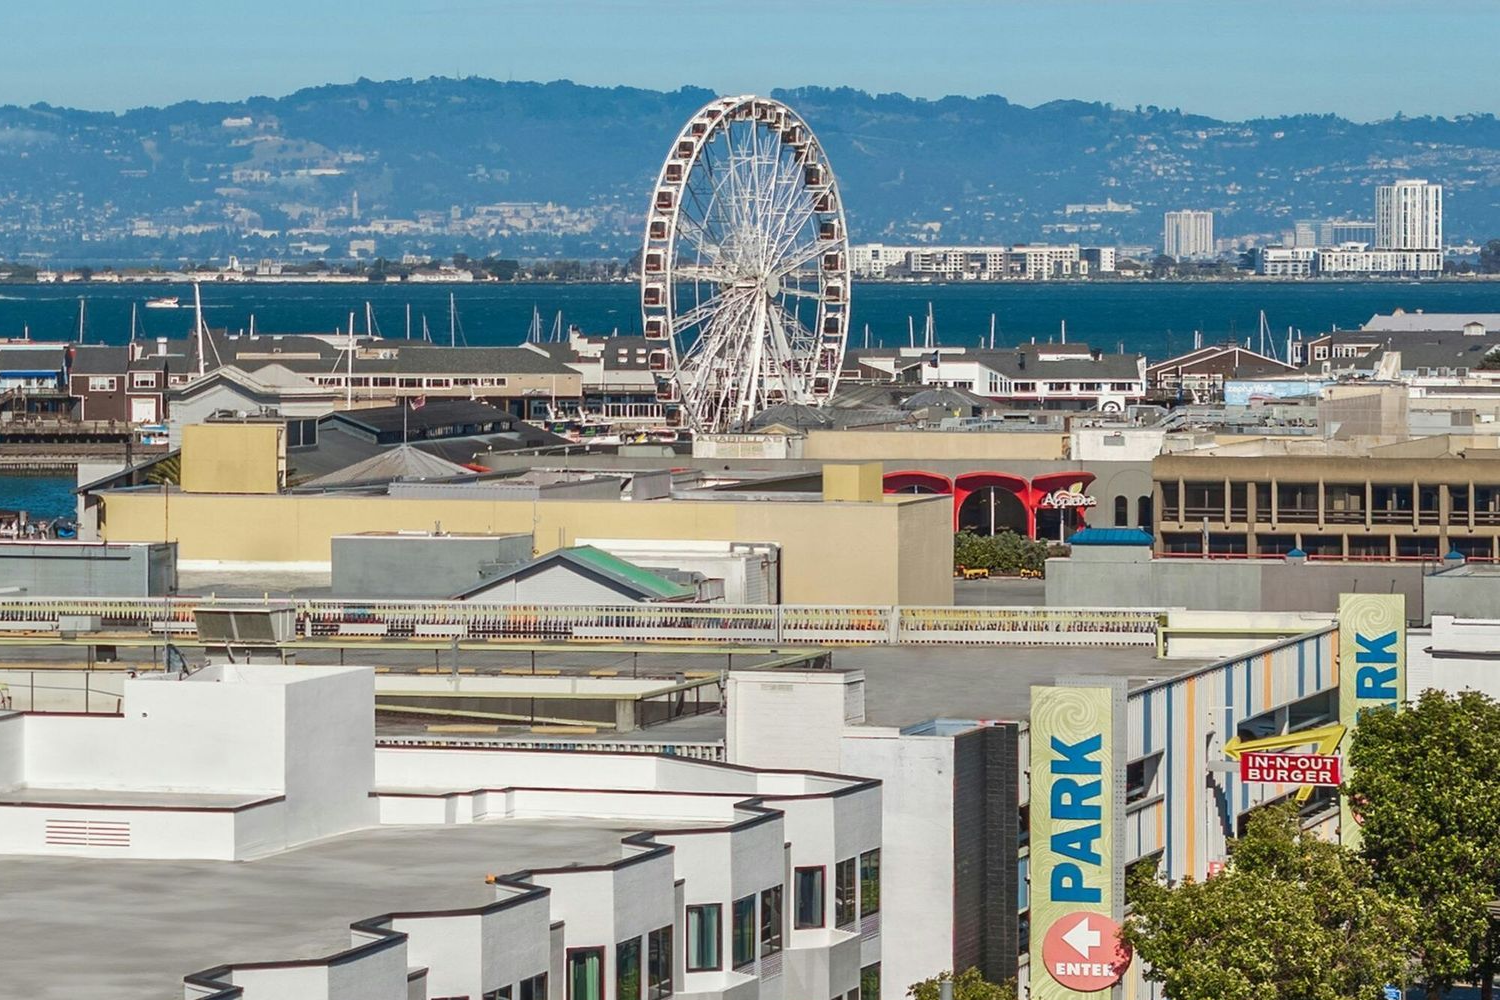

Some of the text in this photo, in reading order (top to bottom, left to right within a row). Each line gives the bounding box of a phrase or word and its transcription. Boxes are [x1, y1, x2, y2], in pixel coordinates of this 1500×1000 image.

[1248, 755, 1334, 770] IN-N-OUT
[1248, 769, 1332, 783] BURGER
[1050, 733, 1102, 903] PARK
[1055, 962, 1116, 977] ENTER
